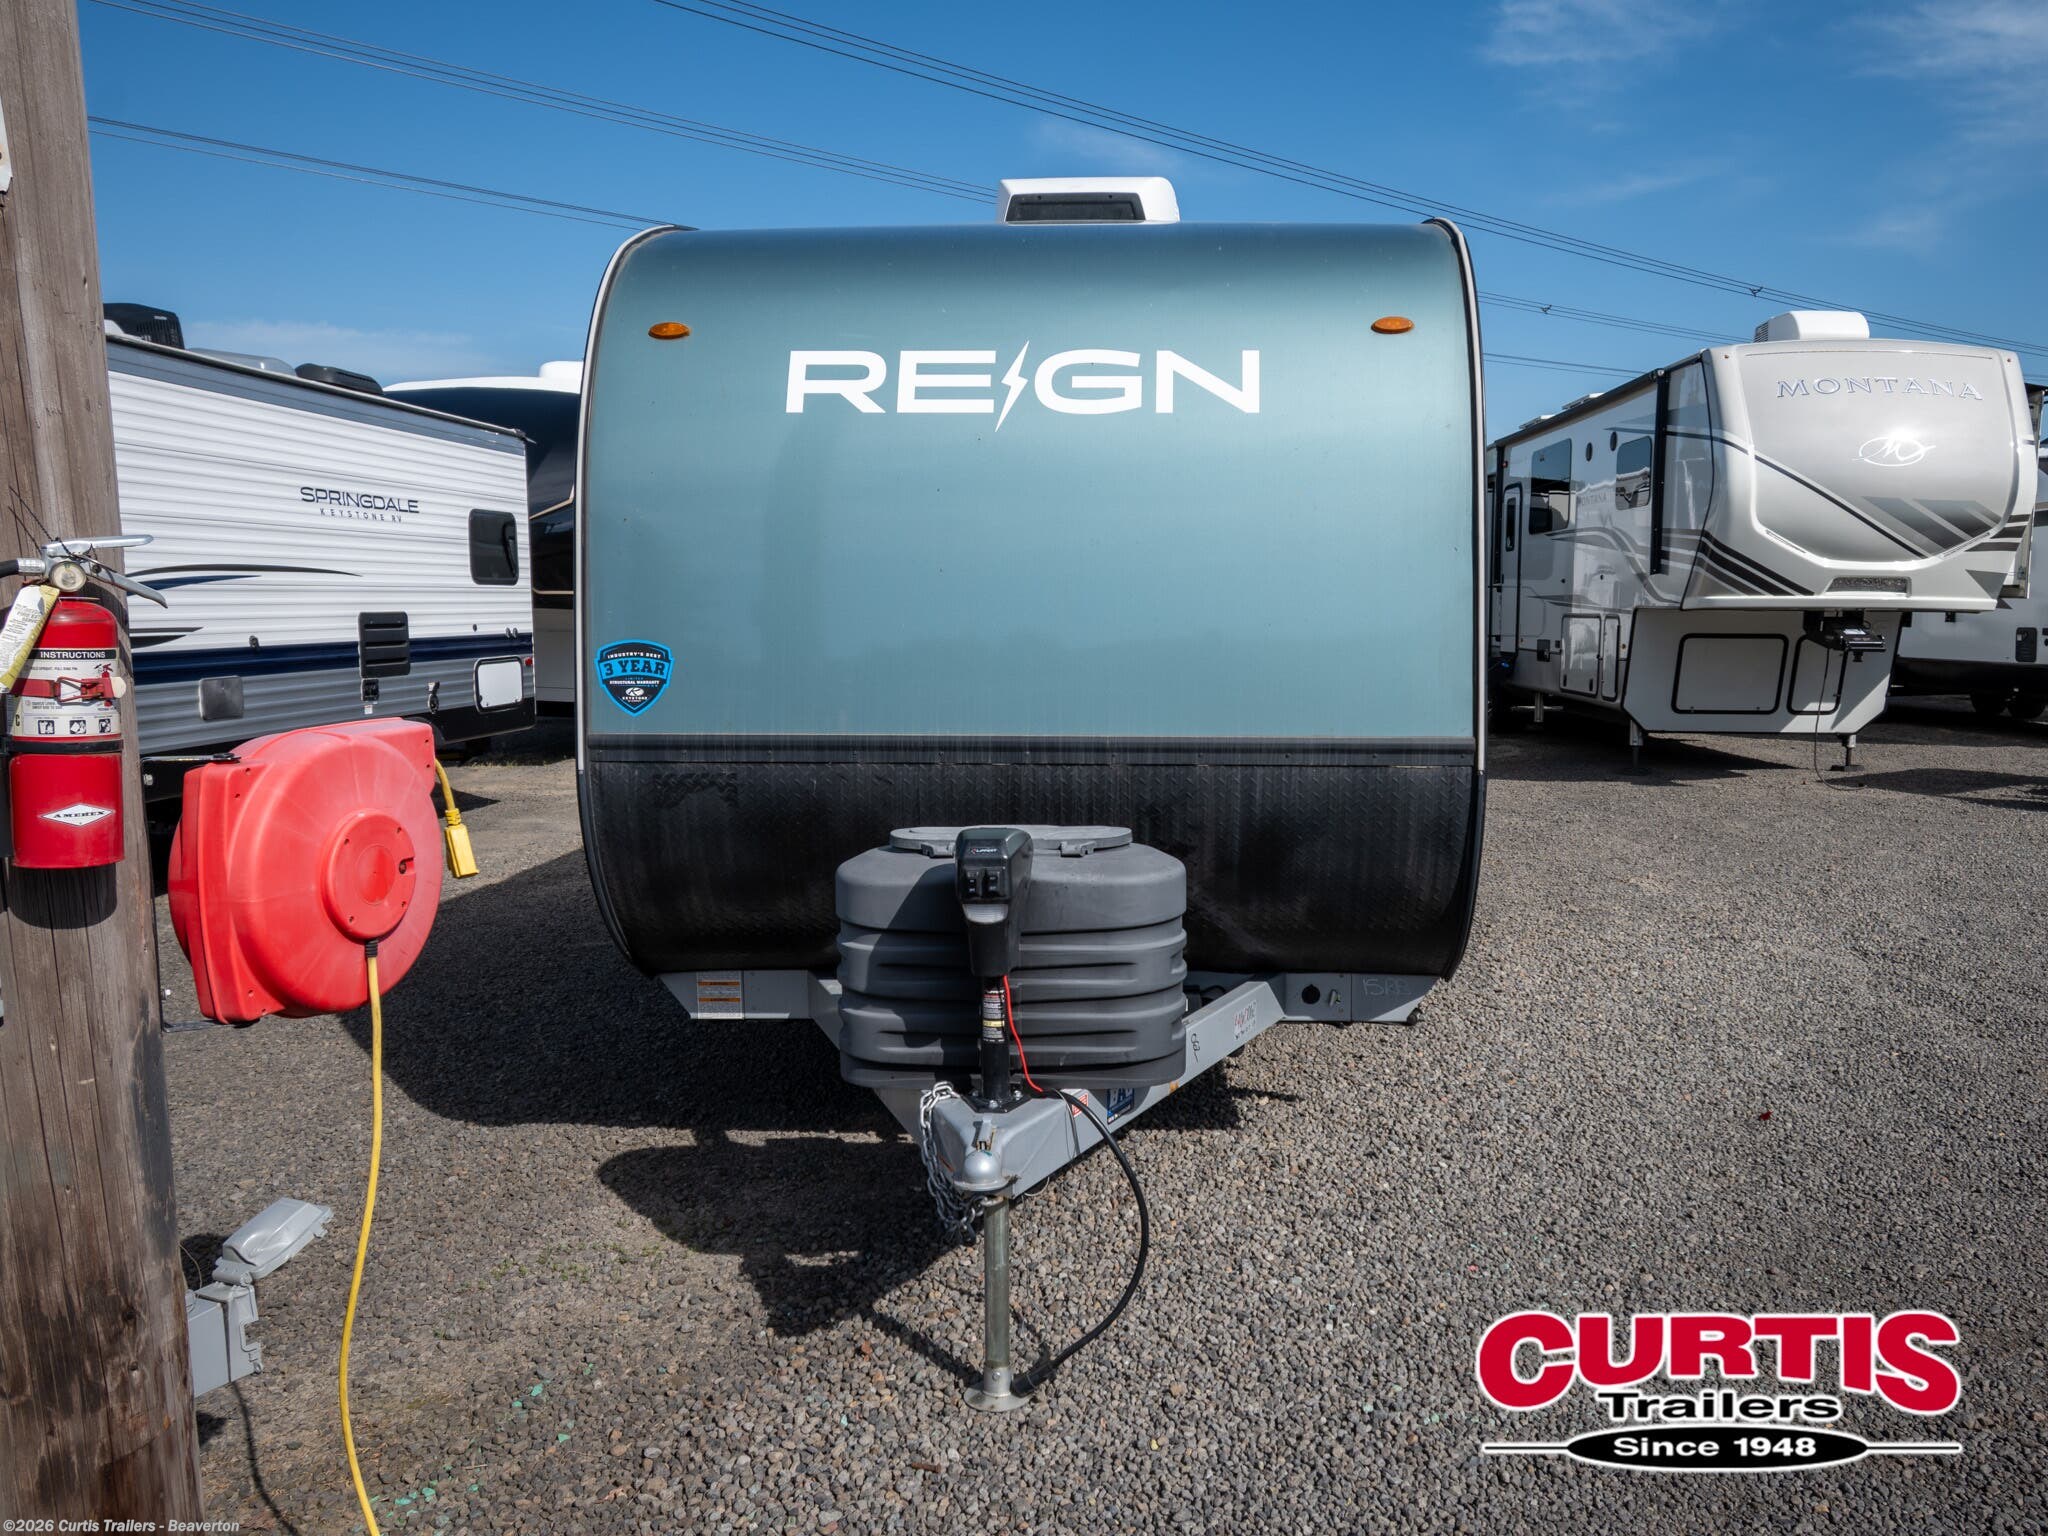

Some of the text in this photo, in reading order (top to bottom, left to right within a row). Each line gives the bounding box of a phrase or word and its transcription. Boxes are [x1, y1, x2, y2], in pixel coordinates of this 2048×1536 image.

[785, 341, 1260, 433] REIGN
[1776, 376, 1984, 401] MONTANA
[300, 486, 420, 514] SPRINGDALE
[320, 508, 402, 523] KEYSTONE RV
[40, 651, 106, 659] INSTRUCTIONS
[604, 659, 666, 676] 3 YEAR
